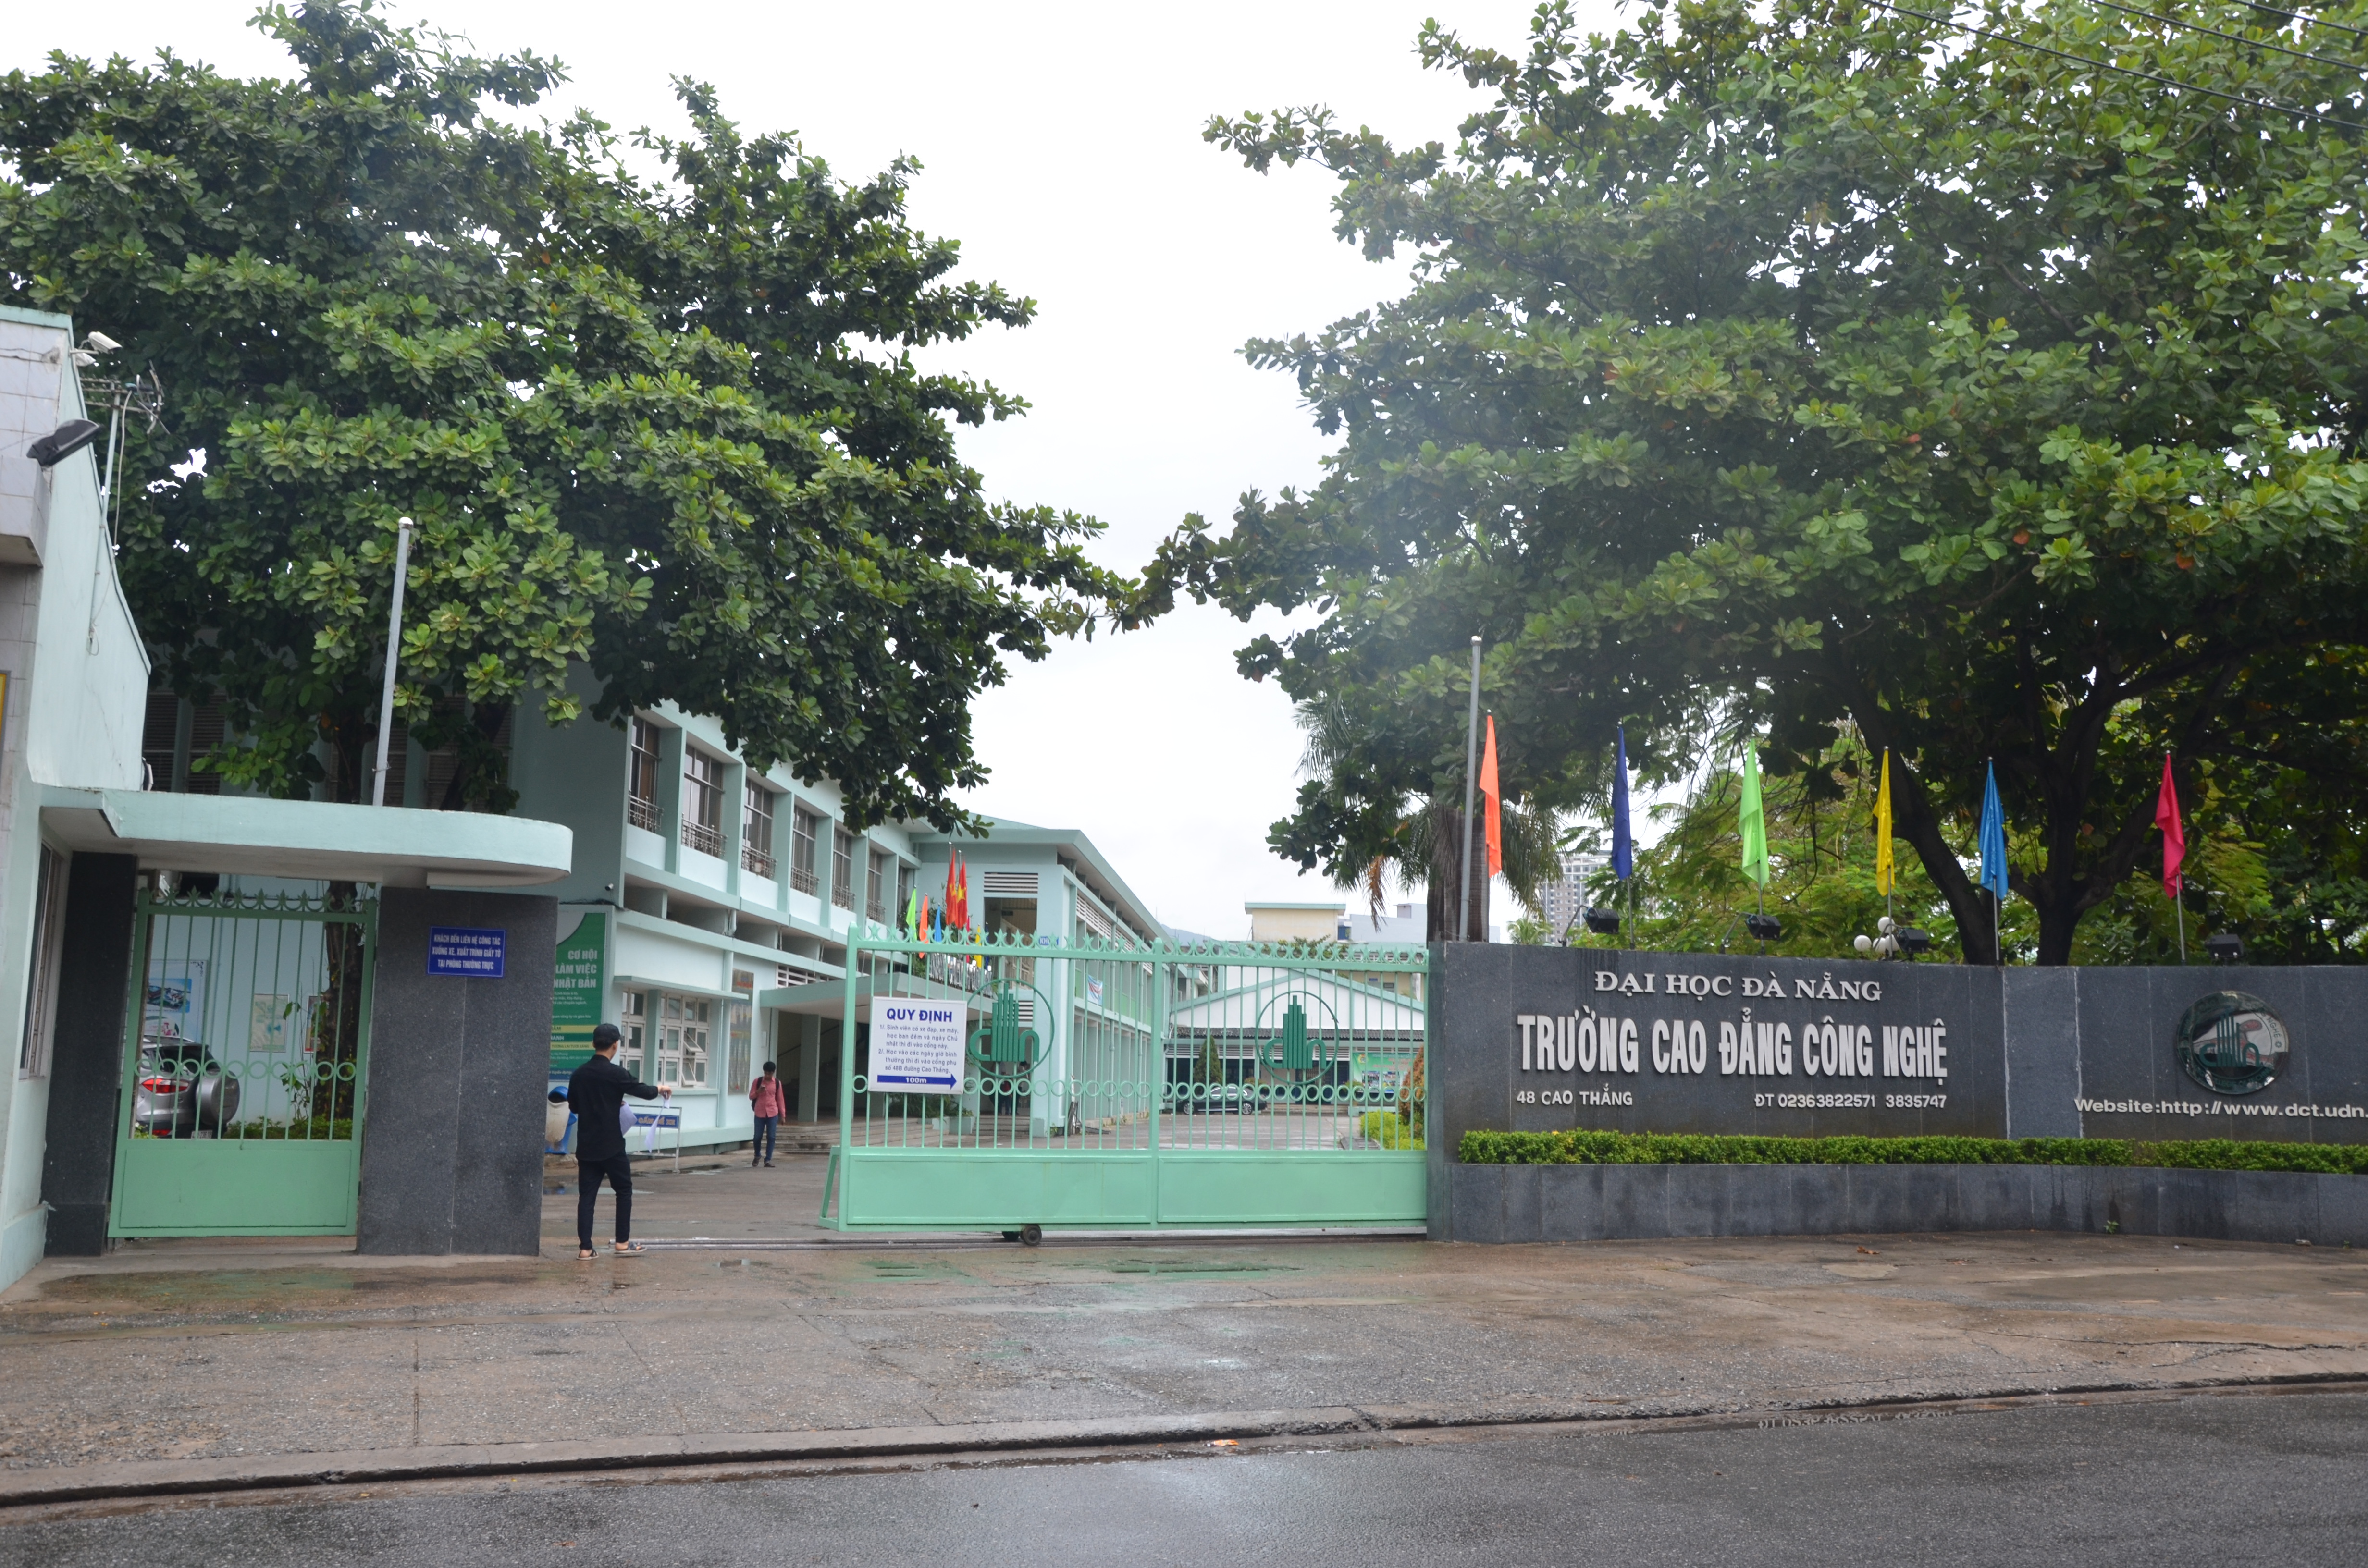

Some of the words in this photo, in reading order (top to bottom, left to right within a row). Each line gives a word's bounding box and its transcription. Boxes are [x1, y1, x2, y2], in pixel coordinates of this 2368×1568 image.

[568, 949, 580, 959] CƠ
[582, 948, 597, 961] HỘI
[556, 963, 573, 974] LÀM
[576, 963, 597, 975] VIỆC
[554, 977, 576, 990] NHẬT
[578, 977, 596, 988] BẢN
[1595, 971, 1655, 997] ĐẠI
[1666, 974, 1732, 1001] HỌC
[1742, 971, 1786, 998] ĐÀ
[1795, 972, 1882, 1001] NẴNG
[887, 1008, 915, 1020] QUY
[919, 1010, 952, 1023] ĐỊNH
[1517, 1005, 1639, 1073] TRƯỜNG
[1652, 1019, 1707, 1074] CAO
[1719, 1007, 1792, 1075] ĐẲNG
[1803, 1016, 1873, 1077] CÔNG
[1883, 1018, 1947, 1085] NGHỆ
[1517, 1091, 1535, 1103] 48
[1542, 1090, 1573, 1105] CAO
[1580, 1083, 1632, 1106] THẮNG
[1754, 1094, 1774, 1107] ĐT
[1778, 1094, 1875, 1107] 02363822571
[1886, 1095, 1947, 1108] 3835747
